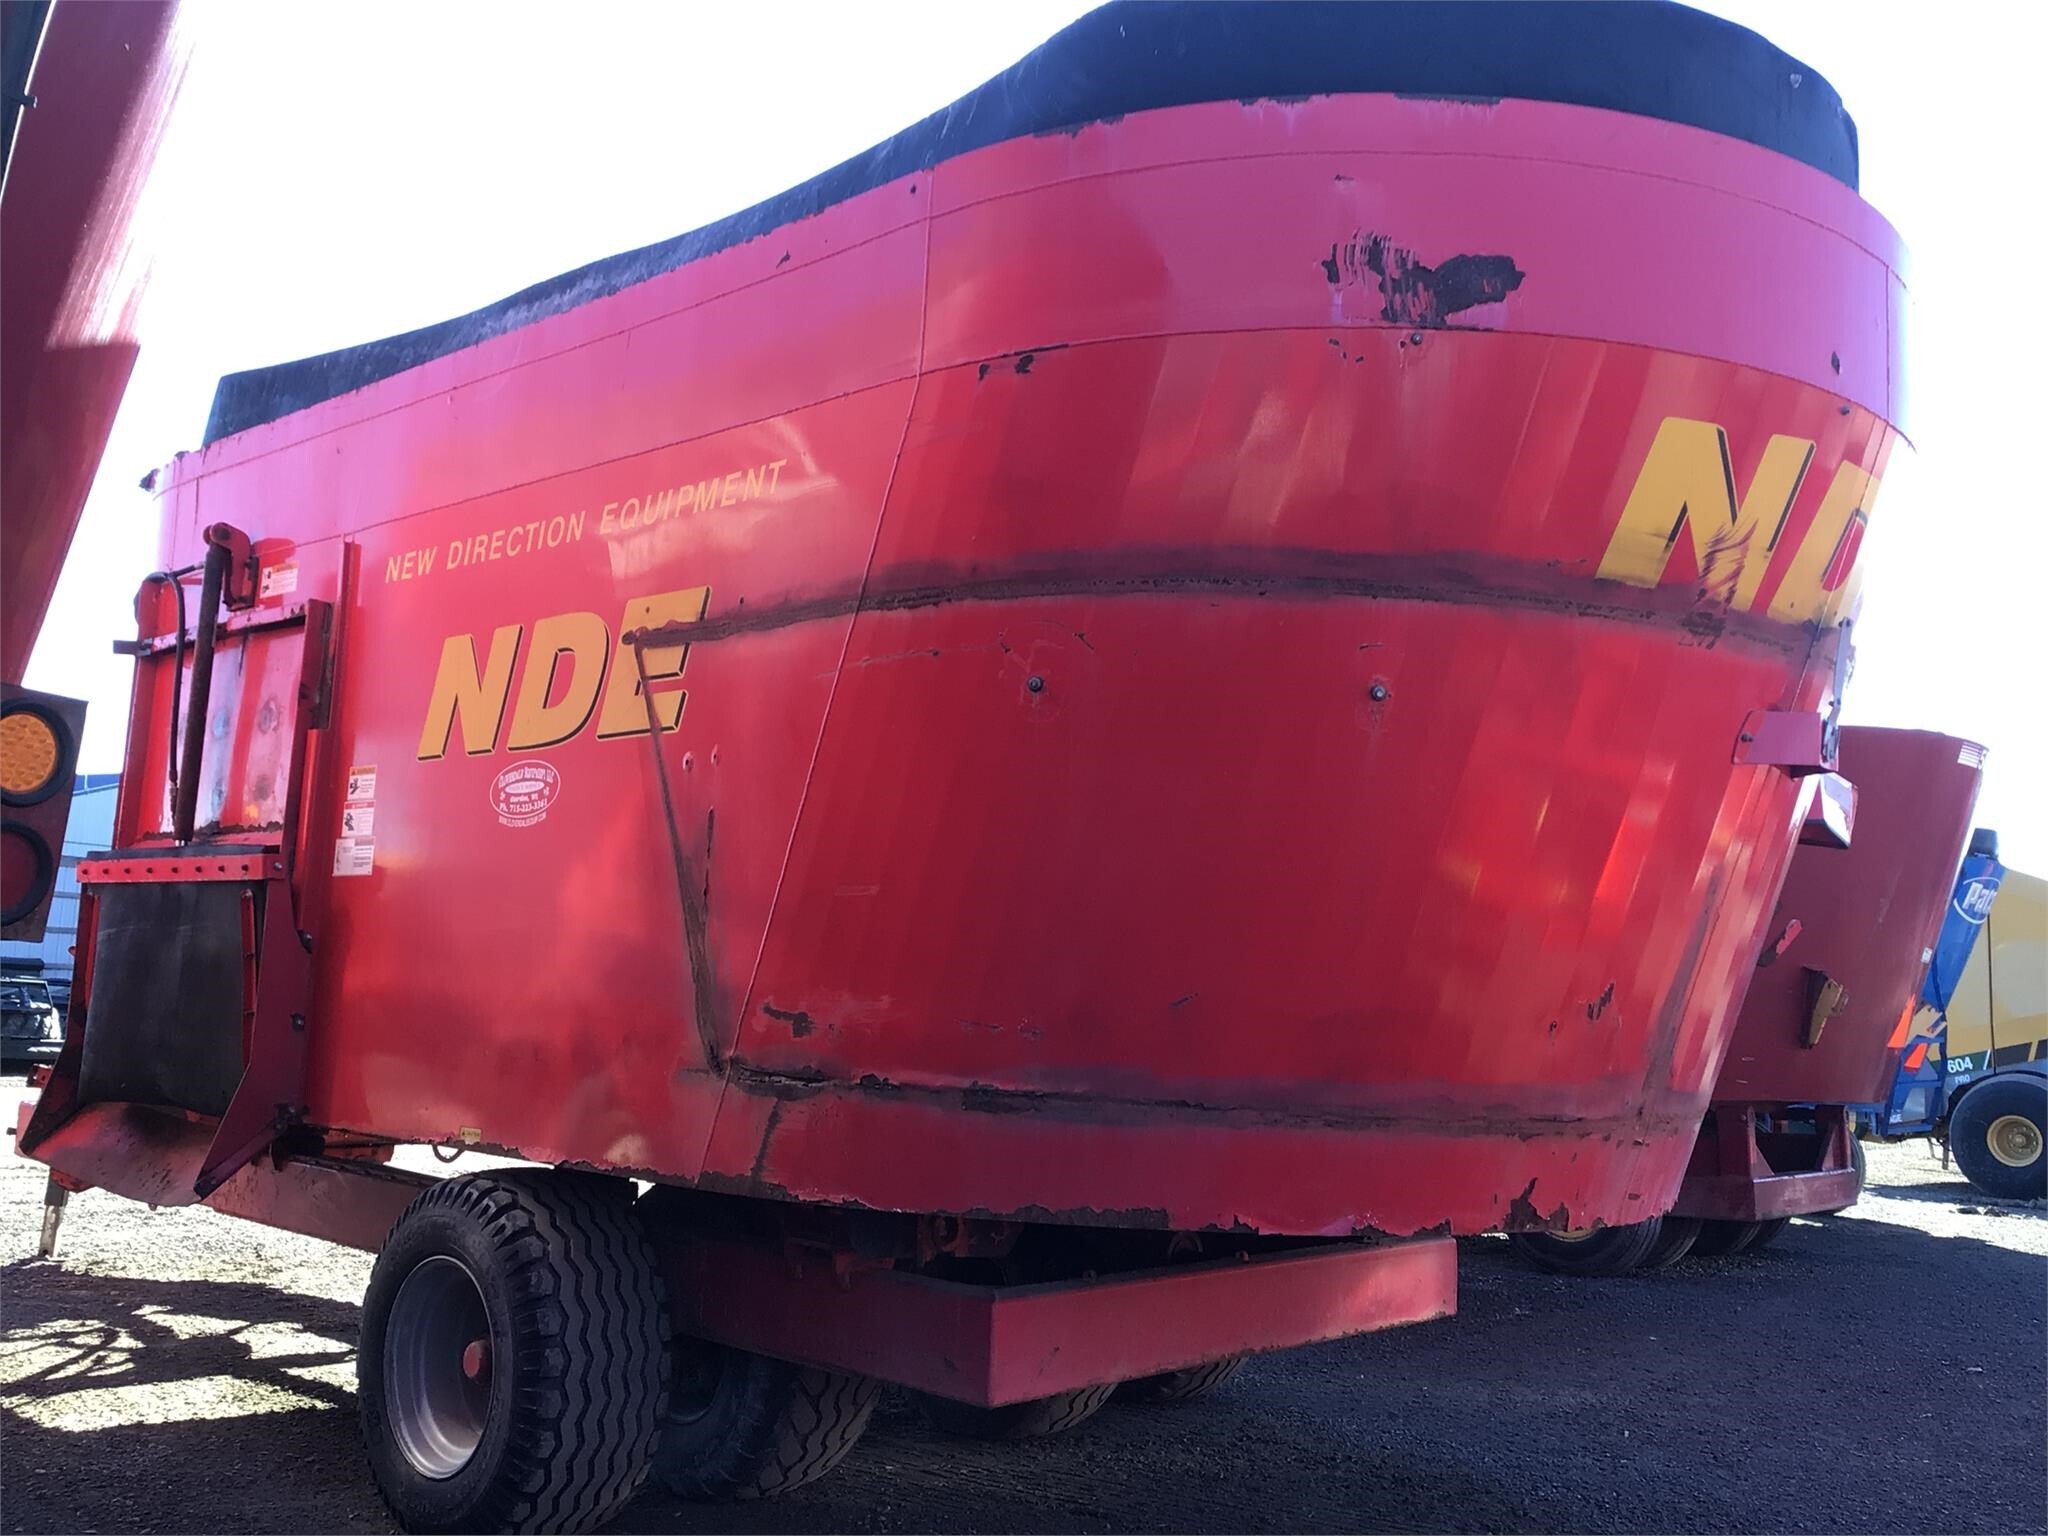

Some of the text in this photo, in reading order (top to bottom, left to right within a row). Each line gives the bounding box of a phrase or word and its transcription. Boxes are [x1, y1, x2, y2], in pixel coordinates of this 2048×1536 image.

[385, 459, 787, 584] NEW DIRECTION EQUIPMENT
[416, 584, 712, 762] NDE
[1946, 1056, 1974, 1074] 604
